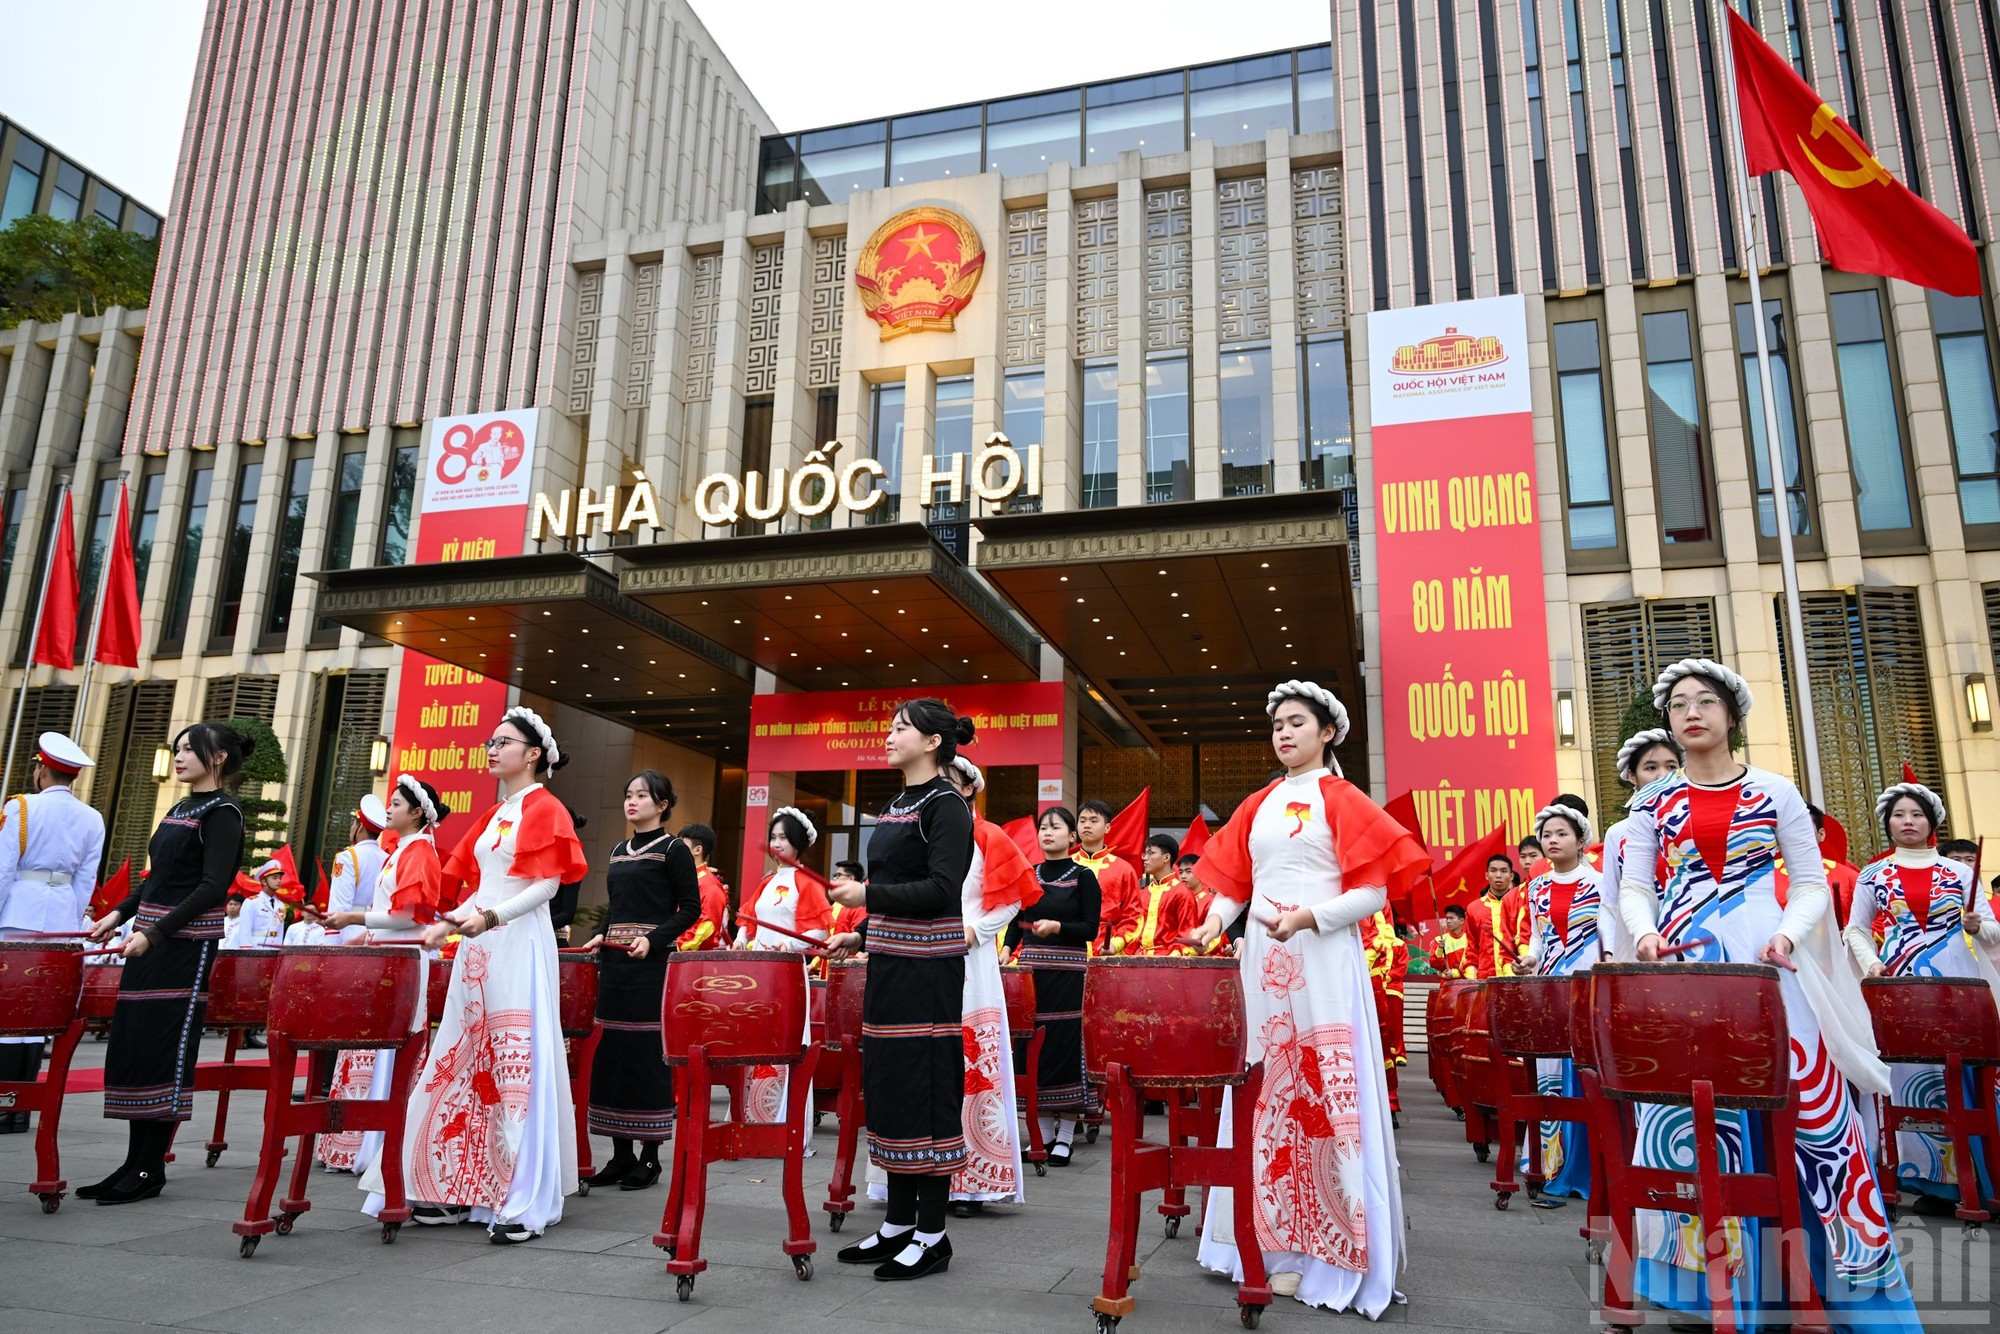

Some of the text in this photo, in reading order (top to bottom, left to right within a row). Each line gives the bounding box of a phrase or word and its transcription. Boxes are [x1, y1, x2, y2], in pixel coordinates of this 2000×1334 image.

[1392, 371, 1506, 391] QUỐC HỘI VIỆT NAM
[1392, 390, 1426, 399] NATIONAL
[1427, 387, 1462, 396] ASSEMBLY
[531, 432, 1042, 542] NHÀ QUỐC HỘI
[1381, 471, 1533, 534] VINH QUANG
[1412, 566, 1513, 633] 80 NĂM
[420, 699, 480, 729] ĐẦU TIÊN
[858, 697, 878, 712] LỄ
[1407, 662, 1529, 749] QUỐC HỘI
[755, 725, 768, 737] 80
[769, 722, 792, 736] NĂM
[794, 721, 820, 736] NGÀY
[822, 718, 847, 735] TỔNG
[848, 717, 878, 733] TUYỂN
[990, 713, 1008, 732] HỘI
[1010, 712, 1031, 730] VIỆT
[1032, 713, 1059, 727] NAM
[399, 742, 427, 772] BẦU
[428, 741, 465, 772] QUỐC
[441, 790, 473, 814] NAM
[1411, 779, 1536, 861] VIỆT NAM
